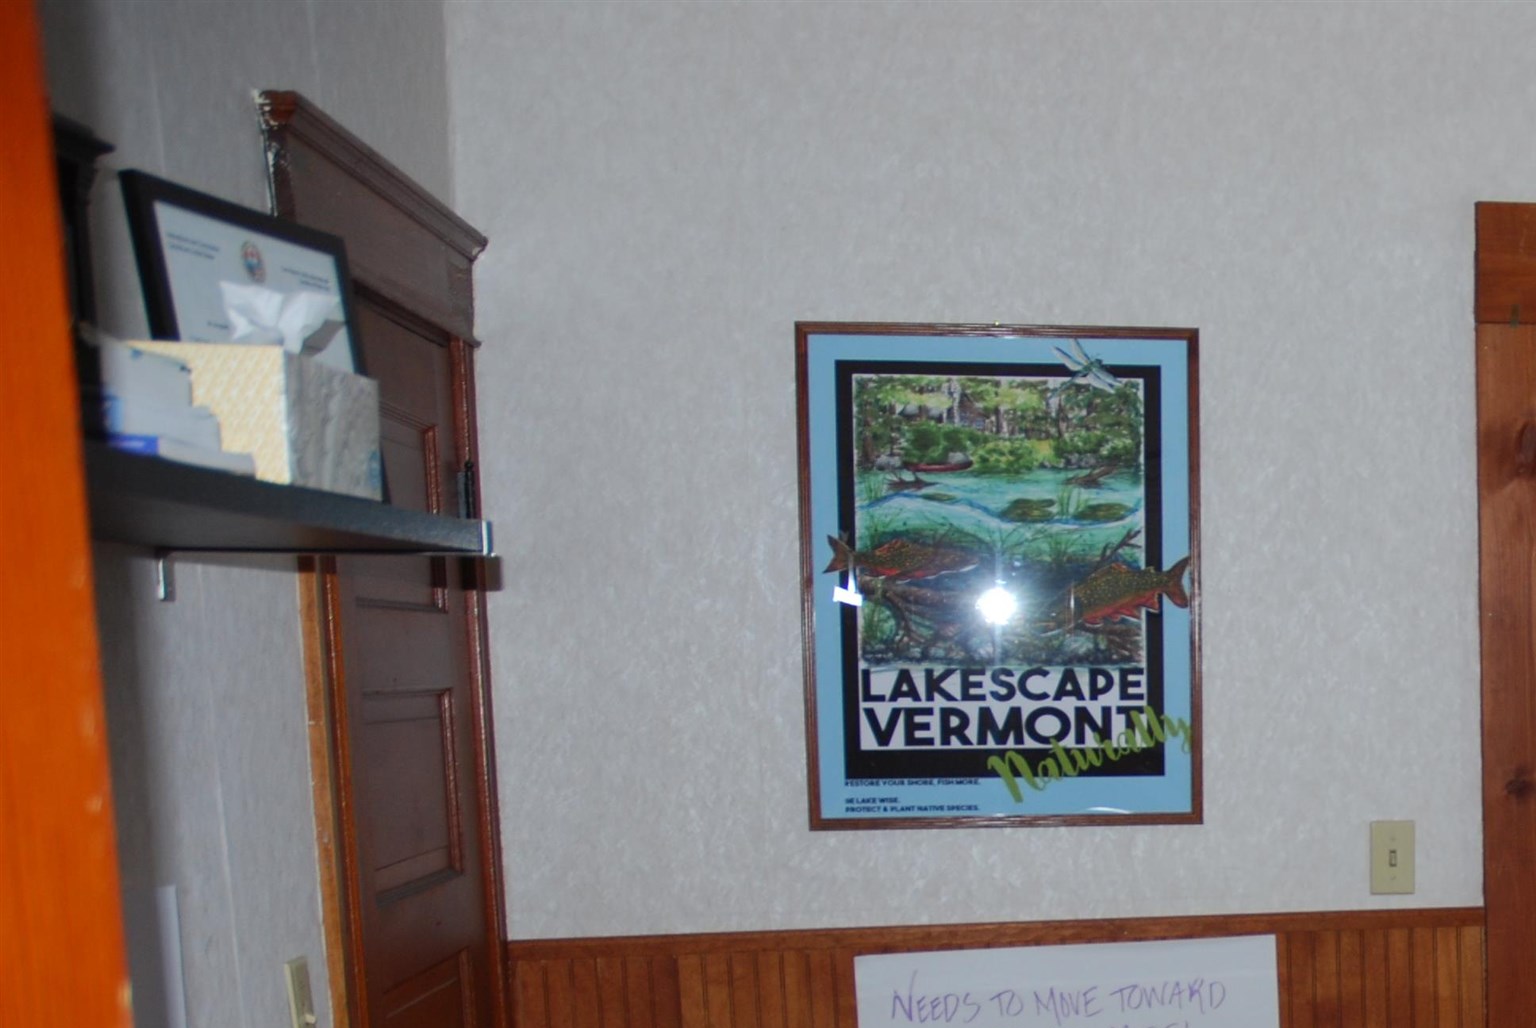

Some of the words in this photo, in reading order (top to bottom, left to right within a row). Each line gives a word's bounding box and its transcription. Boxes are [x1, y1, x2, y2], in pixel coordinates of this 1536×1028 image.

[861, 667, 1146, 703] LAKESCAPE
[863, 705, 1148, 748] VERMONT
[987, 705, 1192, 804] Naturally
[845, 779, 880, 787] RESTORE
[937, 778, 954, 786] FISH
[891, 970, 981, 1024] NEEDS
[989, 988, 1024, 1017] TO
[1033, 984, 1103, 1026] MOVE
[1110, 977, 1227, 1015] TOWARD
